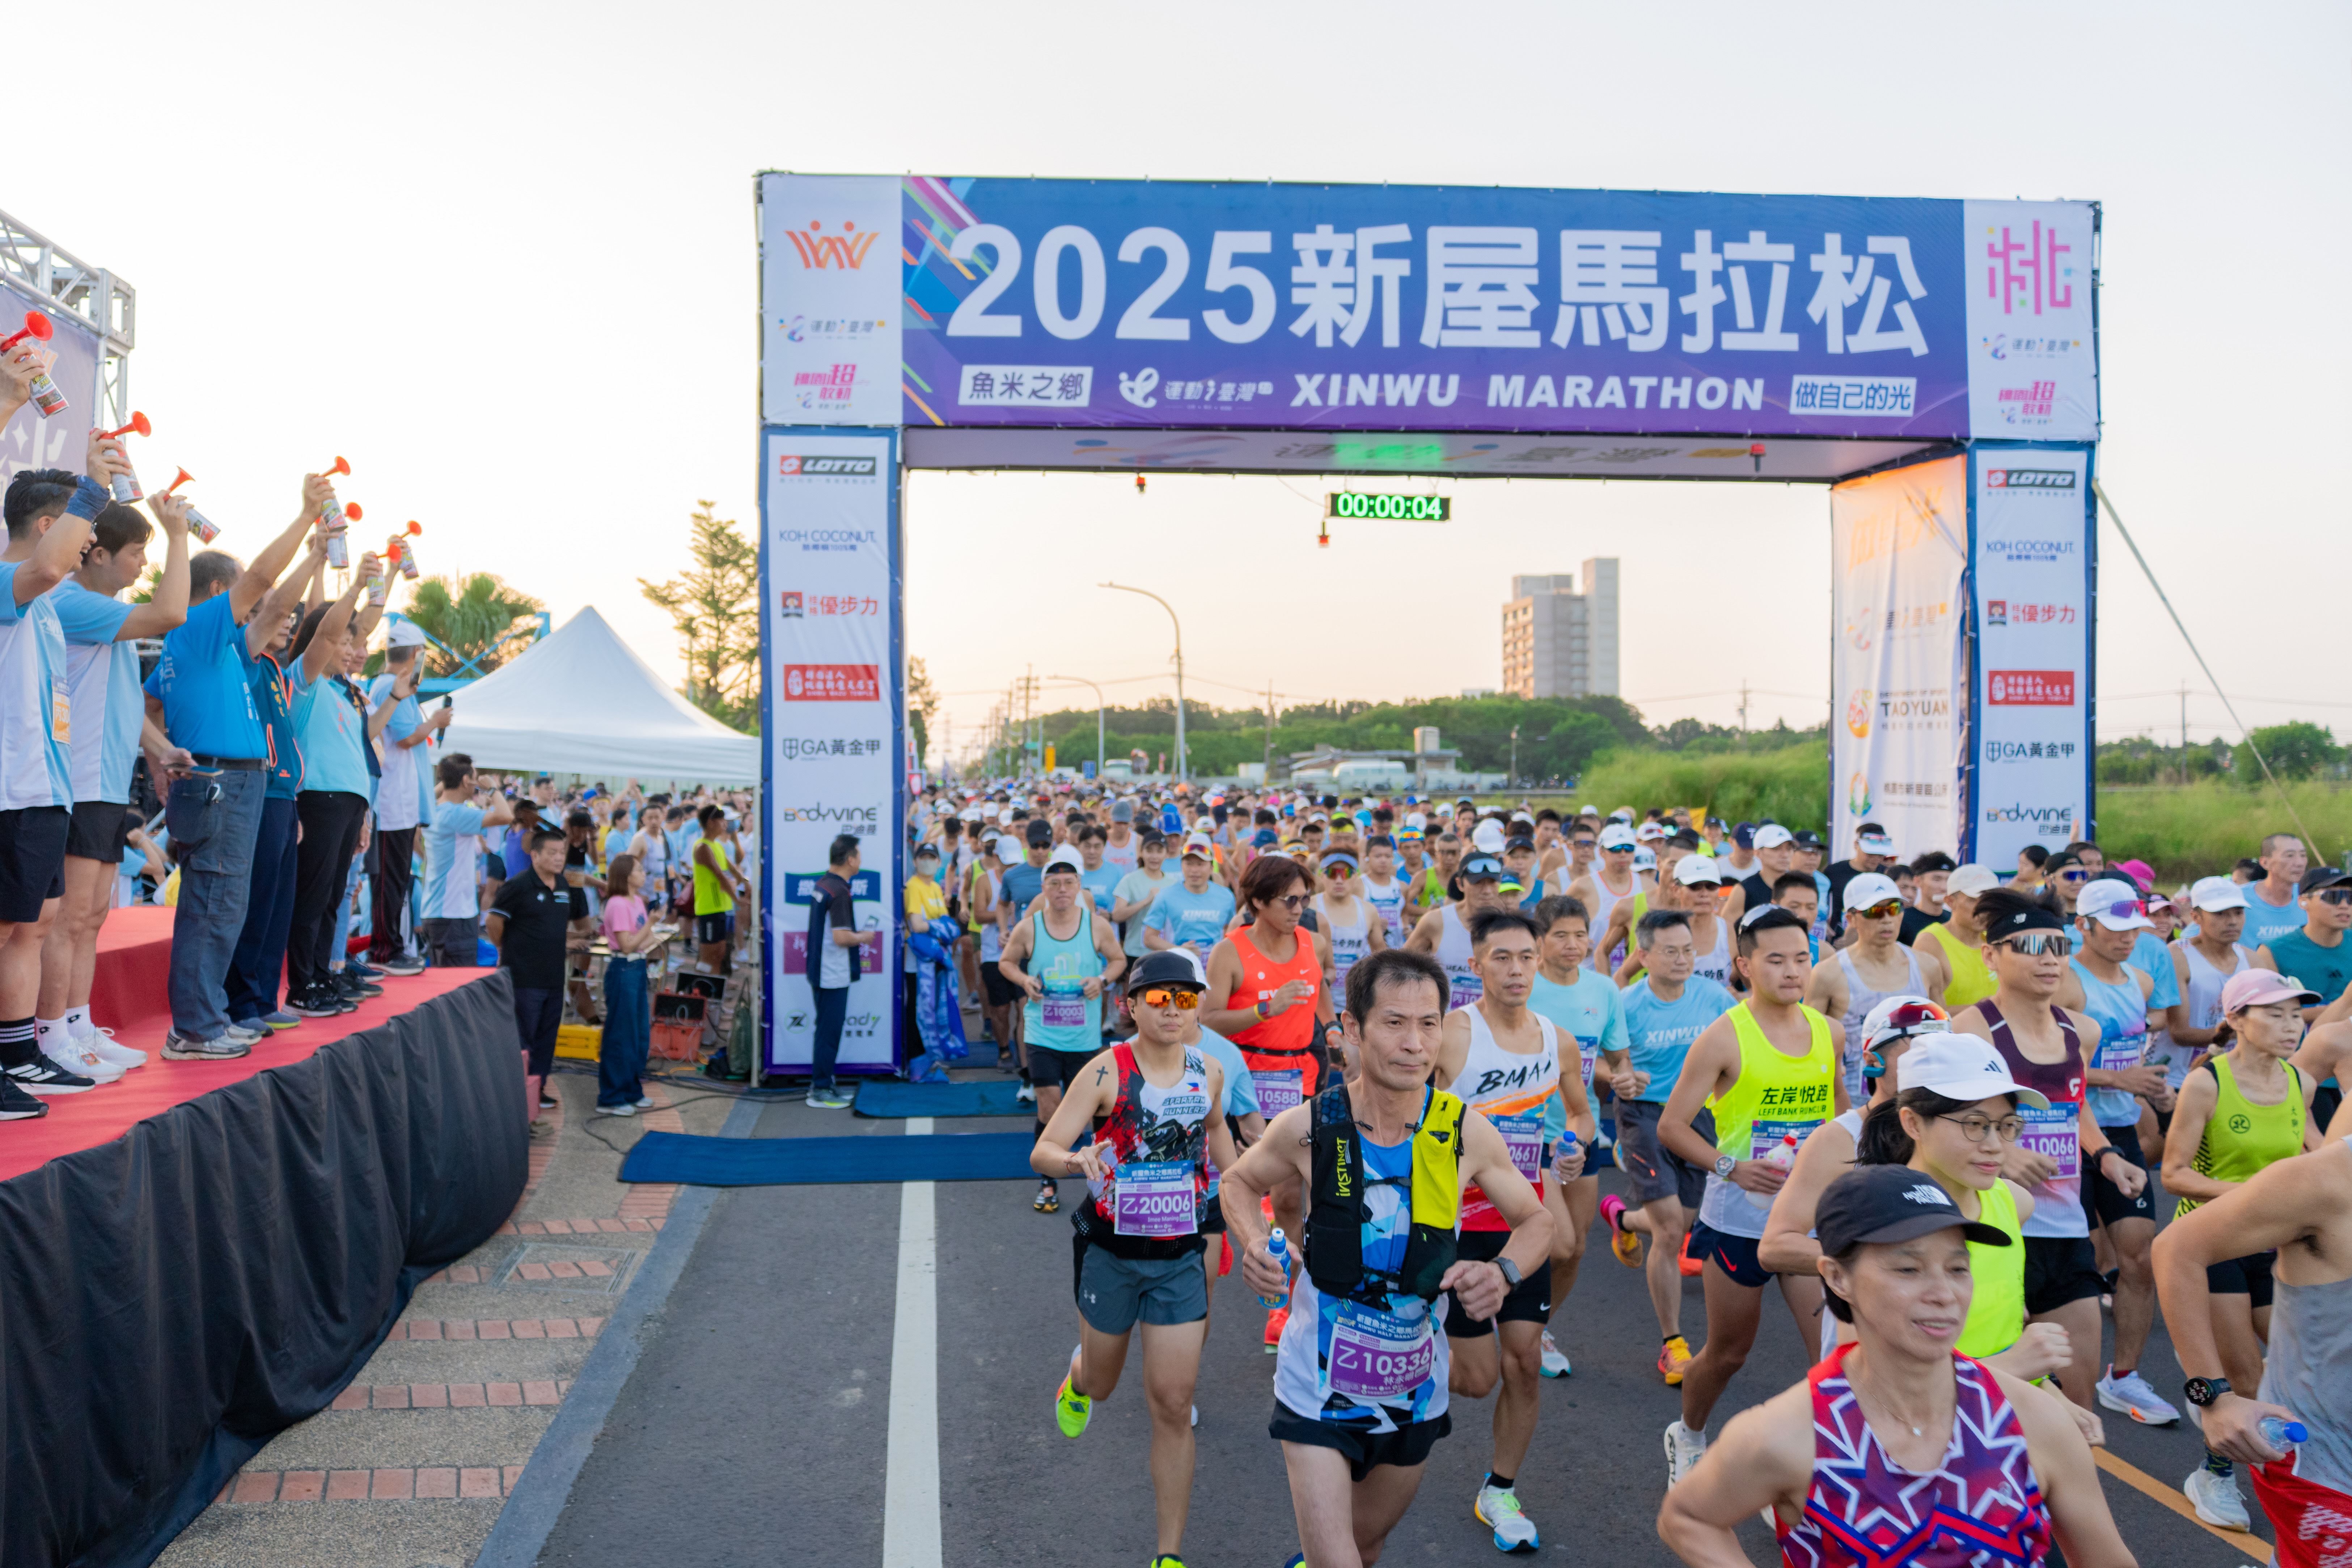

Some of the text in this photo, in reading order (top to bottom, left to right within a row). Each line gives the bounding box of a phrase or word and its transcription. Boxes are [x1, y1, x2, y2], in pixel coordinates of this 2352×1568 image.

[946, 223, 1929, 358] 2025新屋馬拉松
[969, 371, 1084, 401] 魚米之鄉
[1290, 373, 1764, 411] XINWU MARATHON
[1795, 382, 1912, 411] 做自己的光
[803, 459, 873, 472] LOTTO
[2009, 472, 2073, 486] LOTTO
[1338, 492, 1443, 520] 00:00:04
[779, 530, 876, 543] KOH COCONUT
[1987, 541, 2074, 554] KOH COCONUT
[820, 595, 878, 616] 優步力
[2022, 604, 2075, 624] 優步力
[1880, 700, 1948, 717] TAOYUAN
[2257, 924, 2299, 937] XINW
[1162, 1096, 1206, 1106] SPARTAN
[1257, 1089, 1299, 1103] 10588
[1163, 1106, 1207, 1116] RUNNERS
[1758, 1108, 1776, 1116] LEFT
[1777, 1107, 1798, 1115] BANK
[1508, 1145, 1537, 1161] 0661
[2016, 1136, 2074, 1155] 10066
[1122, 1194, 1190, 1215] 乙20006
[1337, 1344, 1430, 1375] 乙10336
